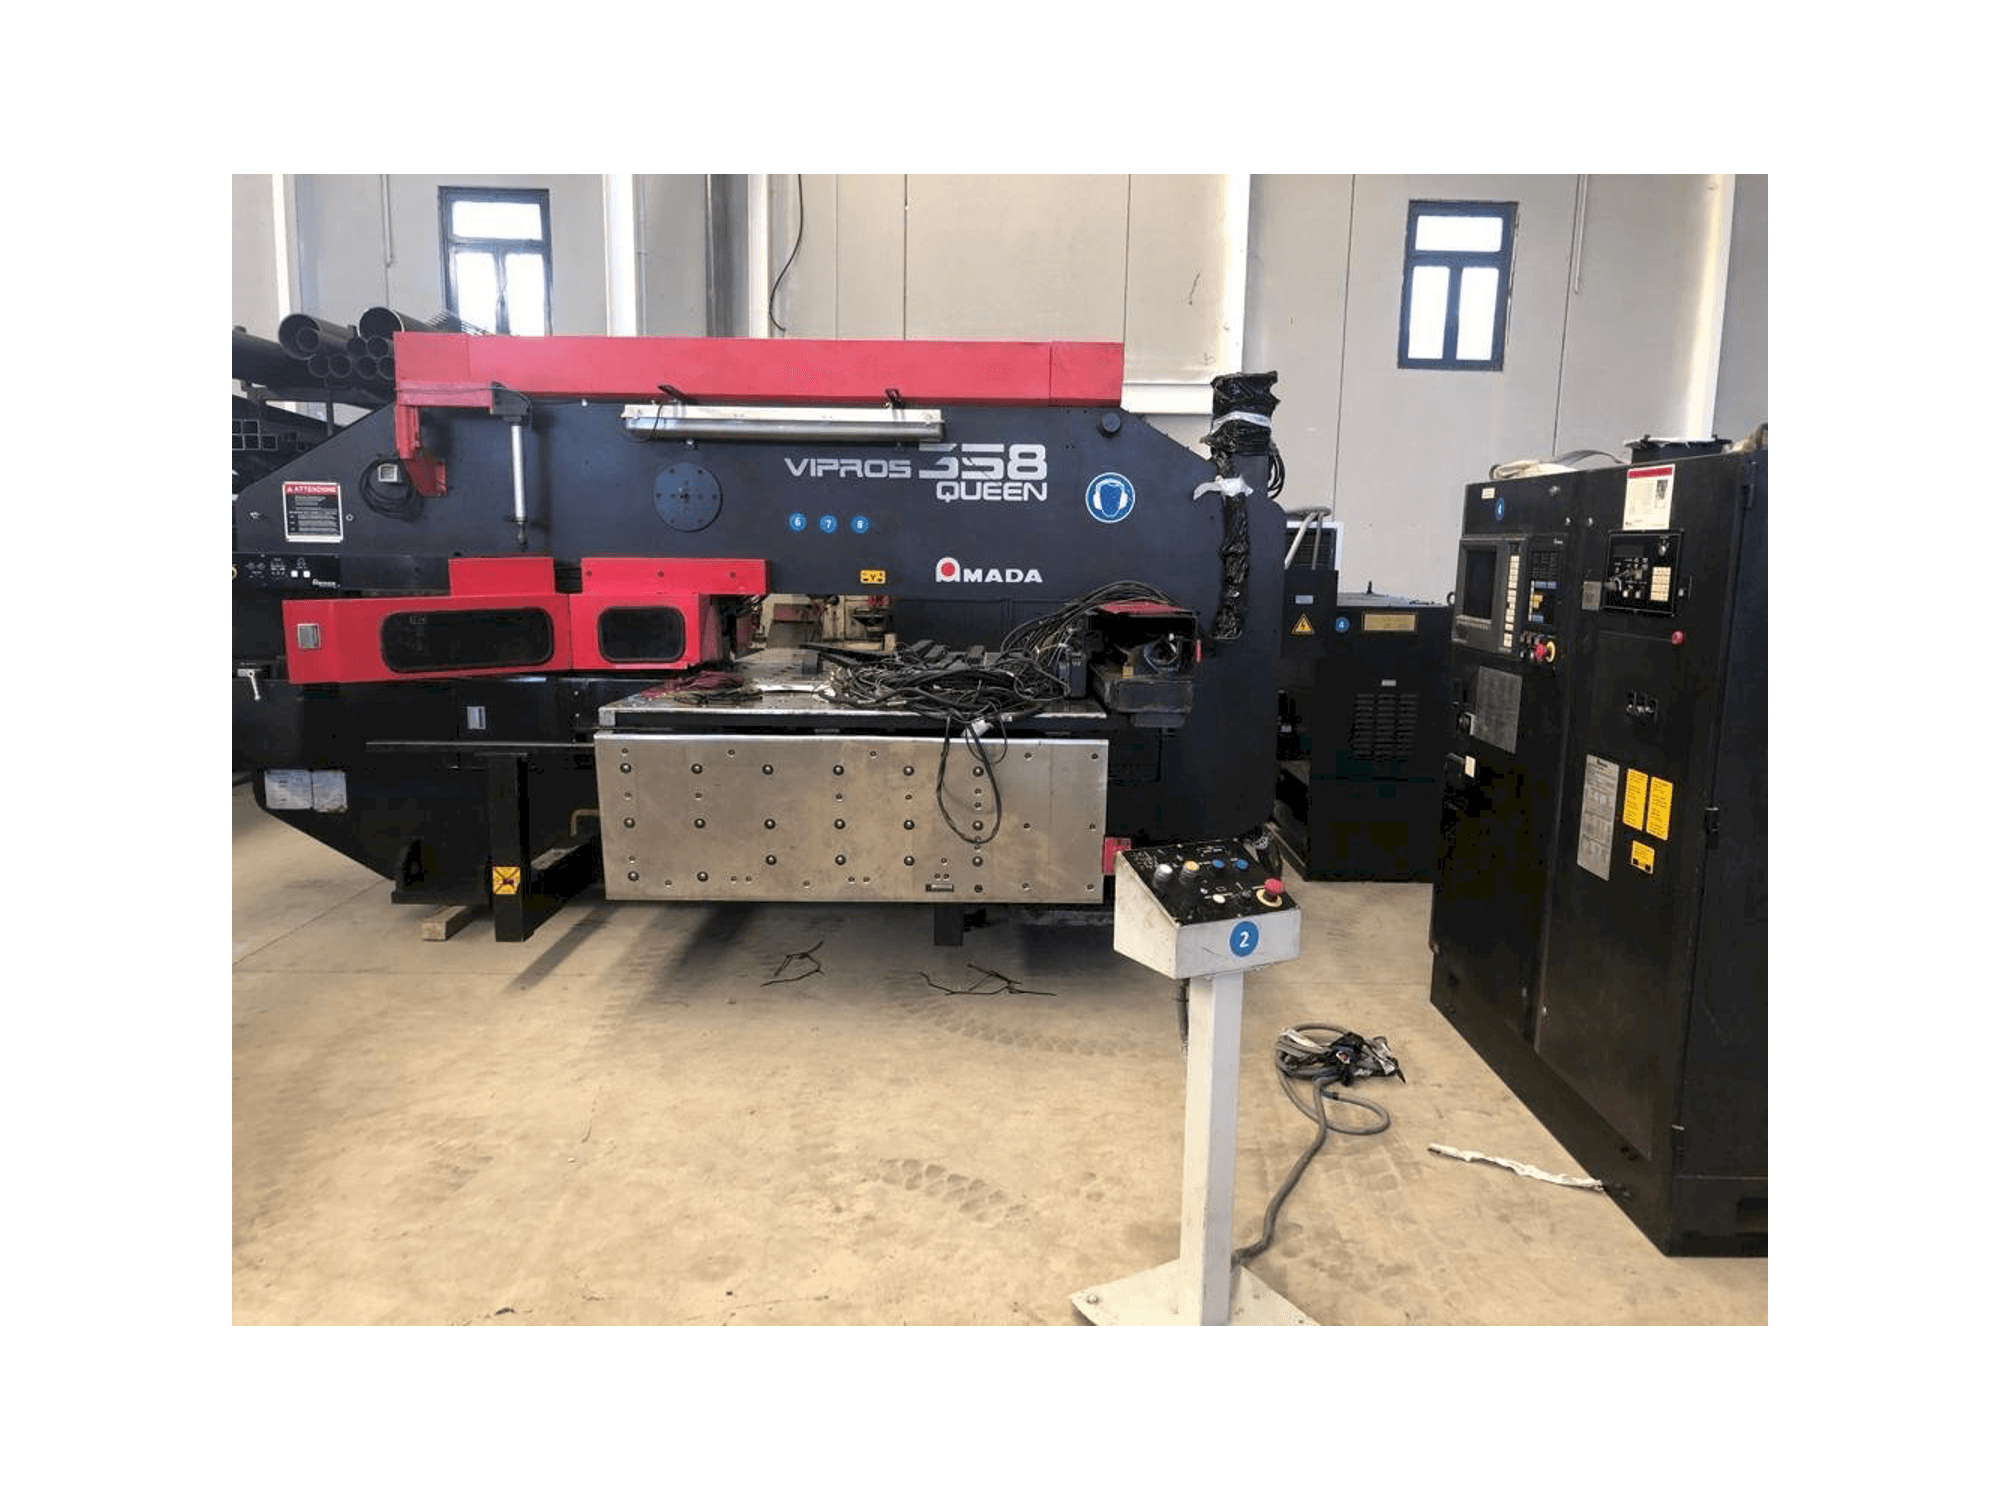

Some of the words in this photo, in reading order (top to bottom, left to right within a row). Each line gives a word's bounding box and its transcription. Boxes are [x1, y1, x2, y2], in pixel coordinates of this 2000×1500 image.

[784, 458, 911, 479] VIPROS
[919, 443, 1048, 480] 358
[936, 481, 1048, 503] QUEEN
[935, 556, 1043, 583] AMADA
[1239, 931, 1250, 948] 2
